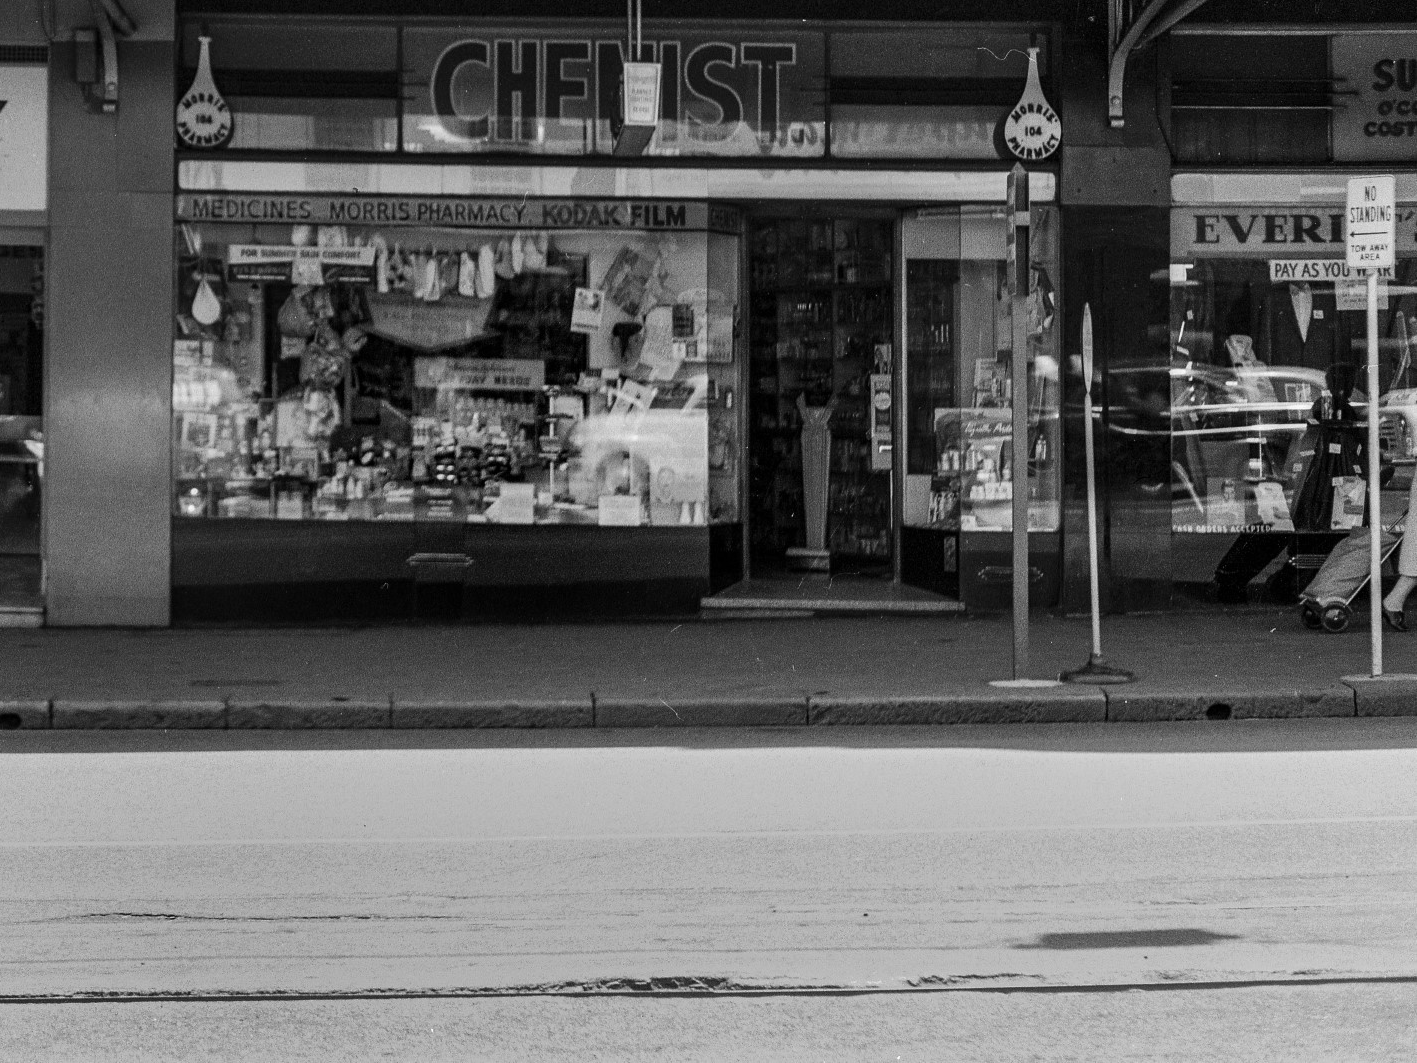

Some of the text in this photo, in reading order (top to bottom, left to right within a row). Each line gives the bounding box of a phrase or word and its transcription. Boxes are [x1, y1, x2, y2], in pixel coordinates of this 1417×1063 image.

[176, 121, 229, 144] PHARMACY
[1024, 126, 1042, 137] 104
[1007, 133, 1059, 159] PHARMACY
[1365, 186, 1376, 201] NO
[192, 199, 687, 226] MEDICINES MORRIS PHARMACY KODAK FILM
[1350, 206, 1391, 223] STANDING
[1351, 244, 1389, 253] TOW AWAY
[1360, 253, 1380, 261] AREA
[1274, 263, 1391, 278] PAY AS YOU WR
